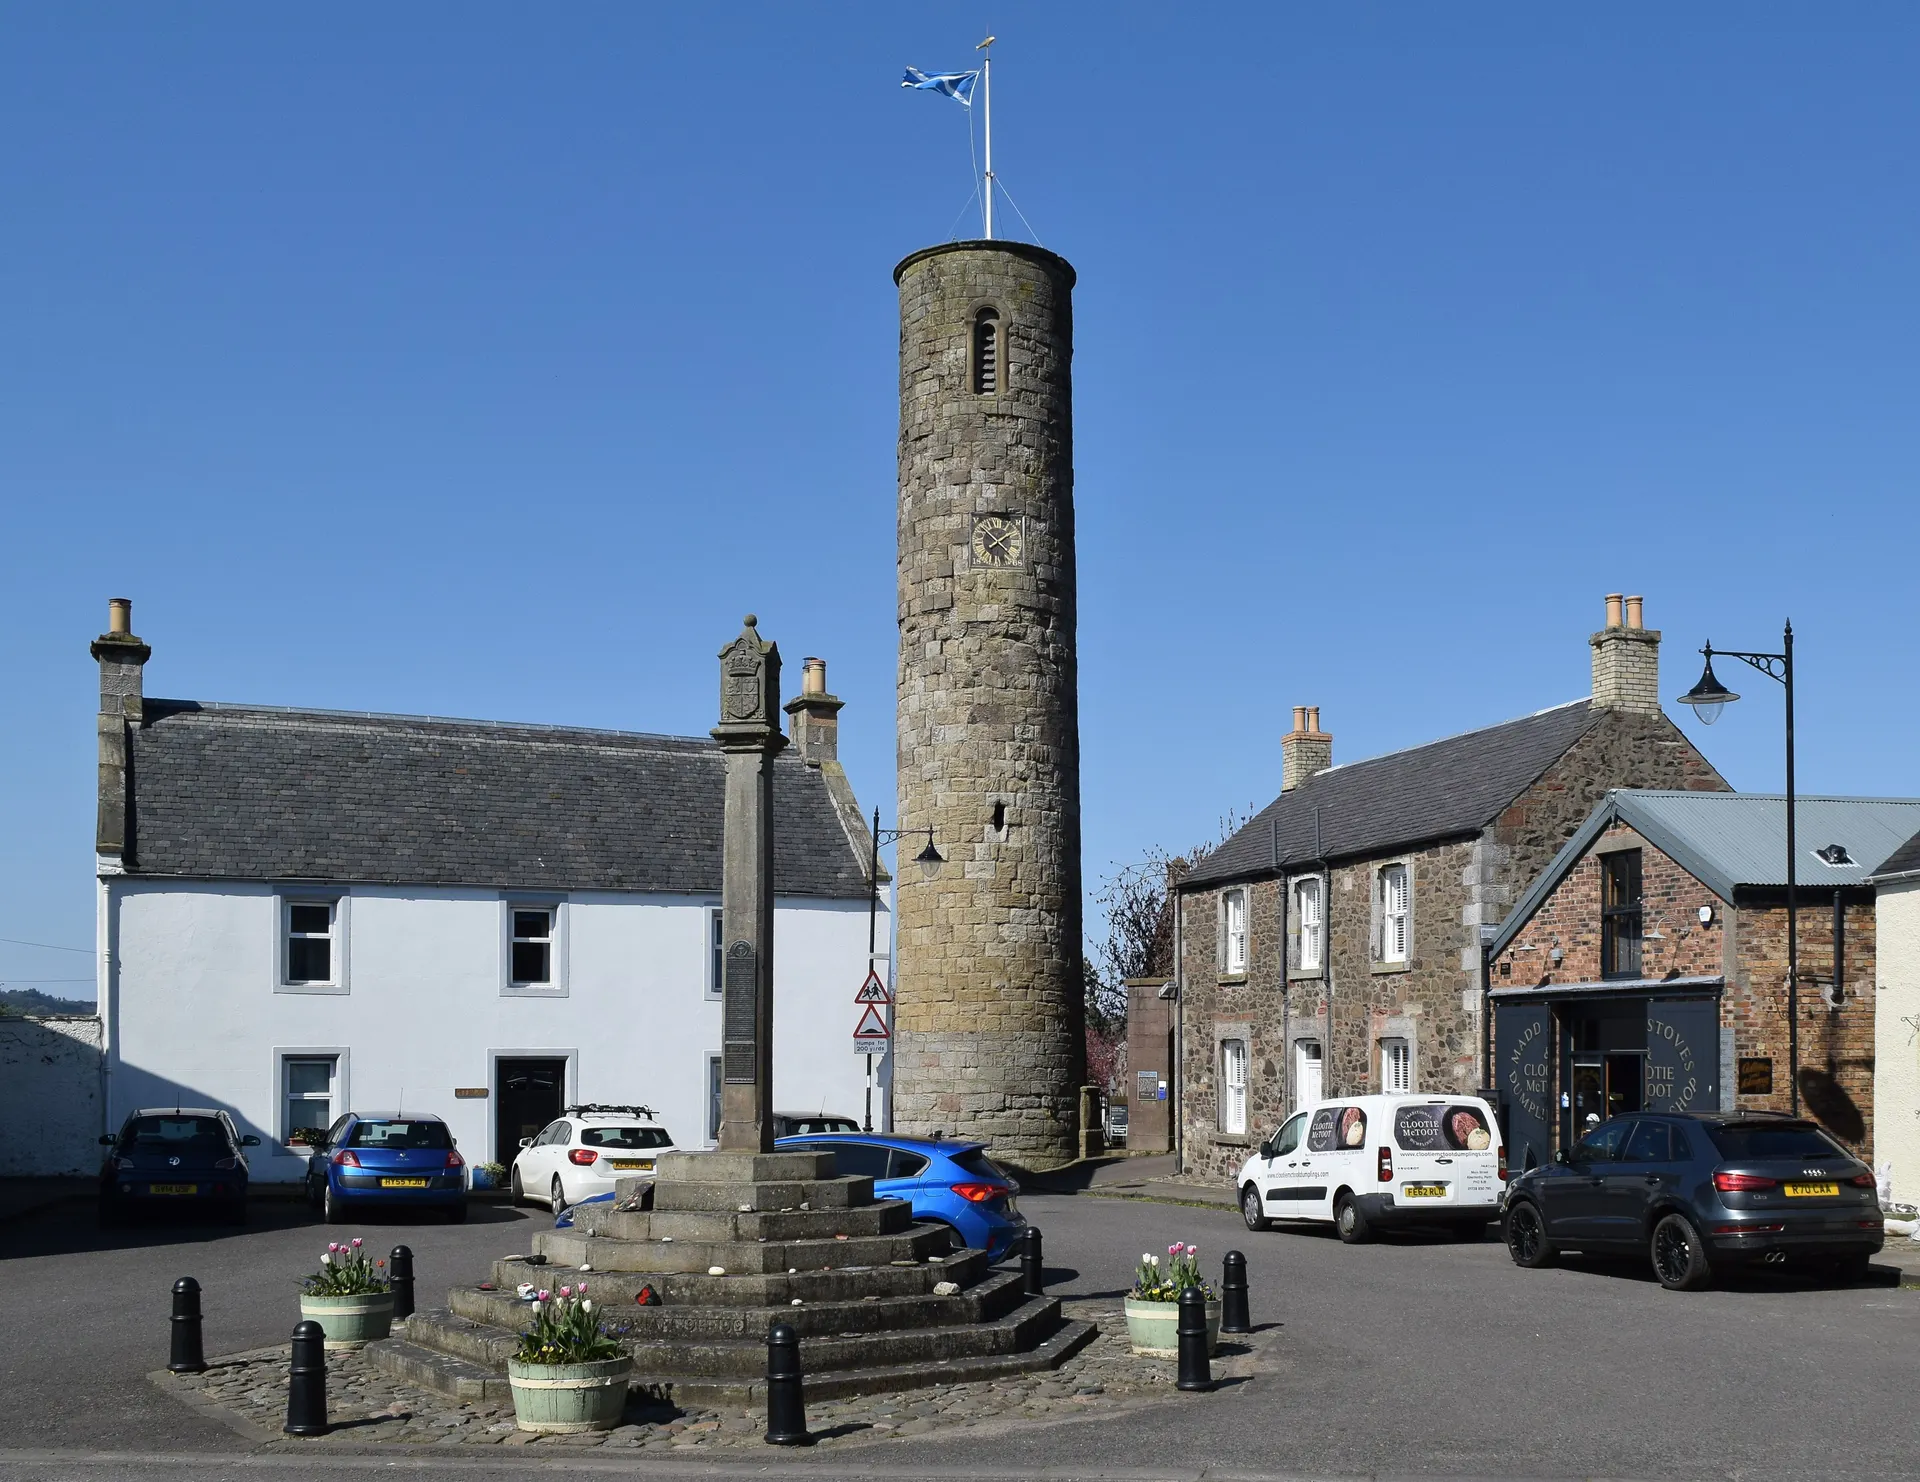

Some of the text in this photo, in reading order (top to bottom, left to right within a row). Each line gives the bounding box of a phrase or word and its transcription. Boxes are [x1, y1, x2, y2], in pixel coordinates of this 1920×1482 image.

[1511, 1021, 1541, 1065] MADD
[1647, 1018, 1695, 1072] STOVES
[1526, 1079, 1547, 1093] McT
[1647, 1083, 1674, 1097] OOT
[1312, 1121, 1334, 1131] CLOOTIE
[1400, 1120, 1440, 1128] CLOOTIE
[1311, 1130, 1332, 1139] McTOOT
[1402, 1128, 1439, 1136] McTOOT
[1407, 1188, 1428, 1196] FE62
[1792, 1183, 1832, 1194] R70 CAA
